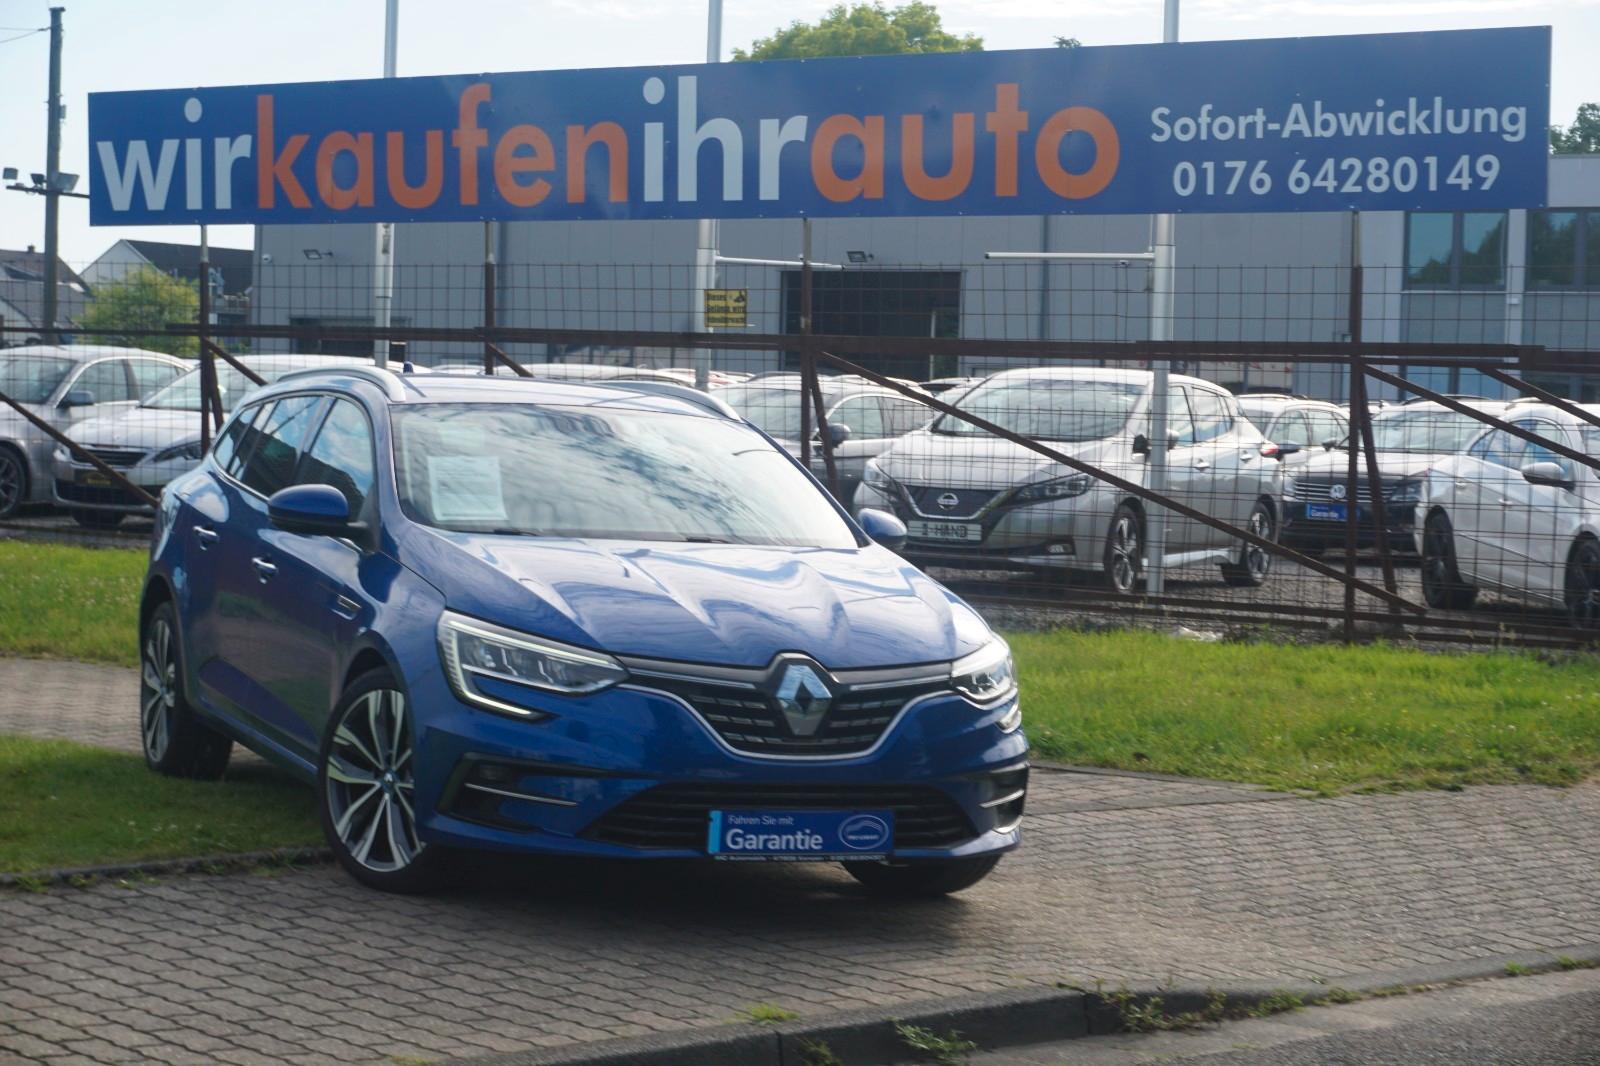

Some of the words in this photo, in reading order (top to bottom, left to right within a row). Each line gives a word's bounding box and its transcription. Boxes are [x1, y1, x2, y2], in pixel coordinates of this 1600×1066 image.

[1150, 97, 1527, 142] Sofort-Abwicklung
[97, 75, 1121, 211] wirkaufenihrauto
[1173, 160, 1273, 197] 0176
[1288, 154, 1501, 195] 64280149
[725, 828, 824, 850] Garantie
[728, 815, 760, 825] Fahren
[761, 816, 777, 825] Sie
[778, 816, 794, 825] mit
